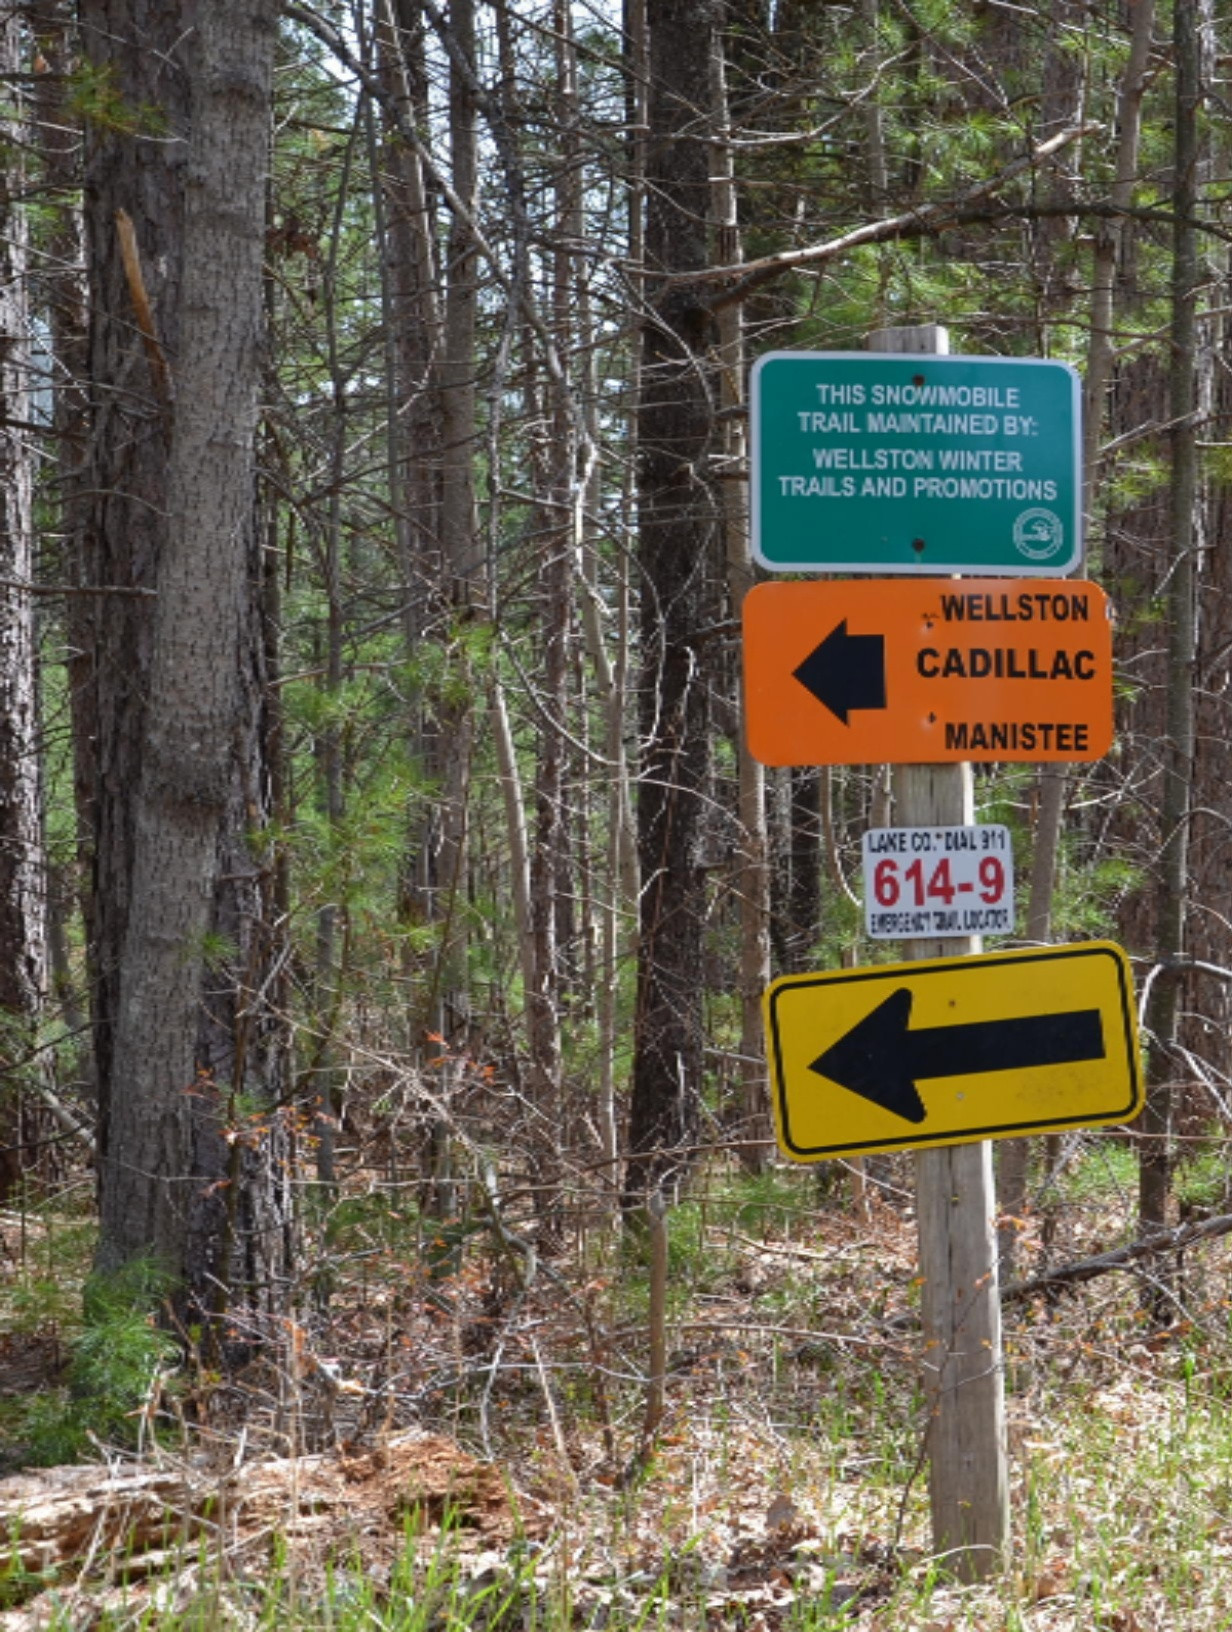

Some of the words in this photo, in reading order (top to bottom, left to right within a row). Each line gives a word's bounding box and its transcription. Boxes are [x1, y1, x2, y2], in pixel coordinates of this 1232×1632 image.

[816, 384, 866, 405] THIS
[872, 385, 1020, 408] SNOWMOBILE
[798, 412, 860, 433] TRAIL
[867, 412, 998, 435] MAINTAINED
[1003, 415, 1039, 436] BY:
[813, 448, 933, 470] WELLSTON
[940, 450, 1022, 472] WINTER
[778, 476, 855, 497] TRAILS
[860, 476, 906, 497] AND
[914, 478, 1057, 500] PROMOTIONS
[941, 594, 1088, 621] WELLSTON
[916, 648, 1096, 680] CADILLAC
[945, 722, 1088, 751] MANISTEE
[868, 832, 907, 853] LAKE
[945, 830, 977, 851] DIAL
[982, 830, 1005, 849] 911
[874, 856, 1005, 907] 614-9
